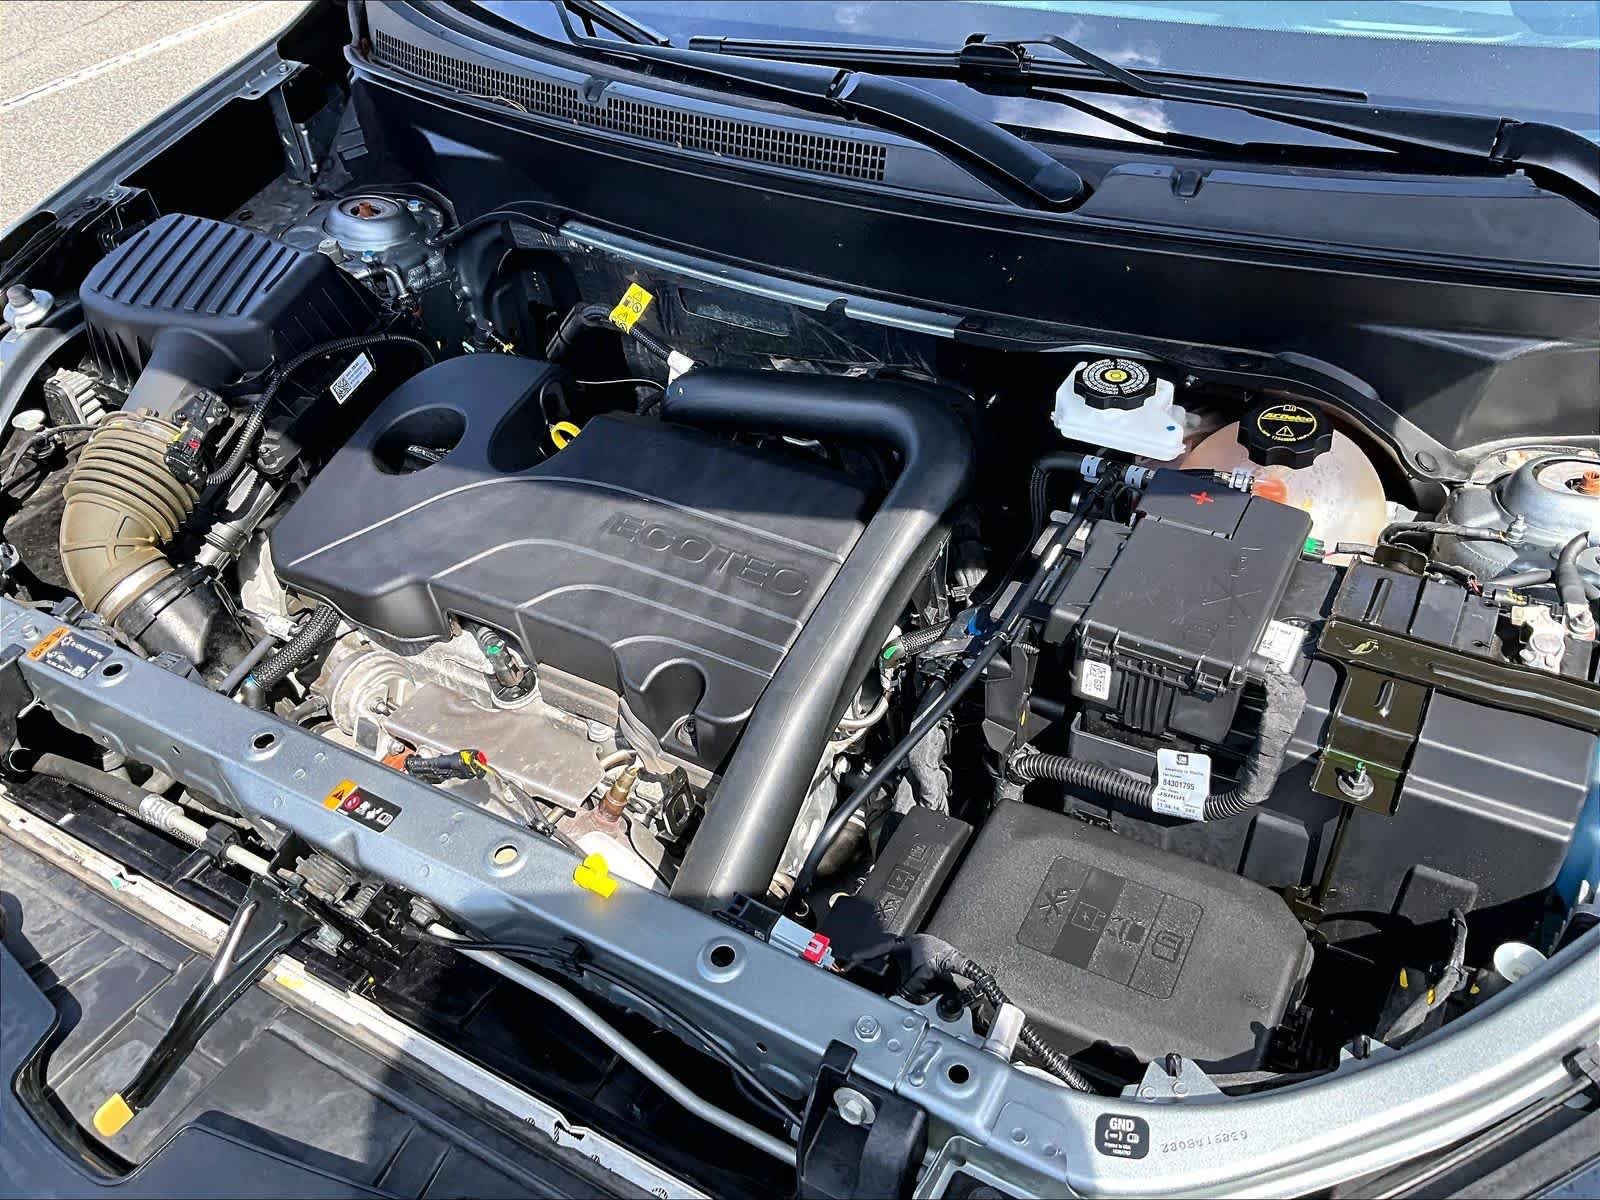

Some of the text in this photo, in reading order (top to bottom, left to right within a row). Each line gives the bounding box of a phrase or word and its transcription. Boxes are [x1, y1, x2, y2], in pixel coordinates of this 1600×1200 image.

[604, 512, 809, 596] ECOTEC
[1162, 779, 1195, 790] 84301795
[1110, 1117, 1135, 1132] GND
